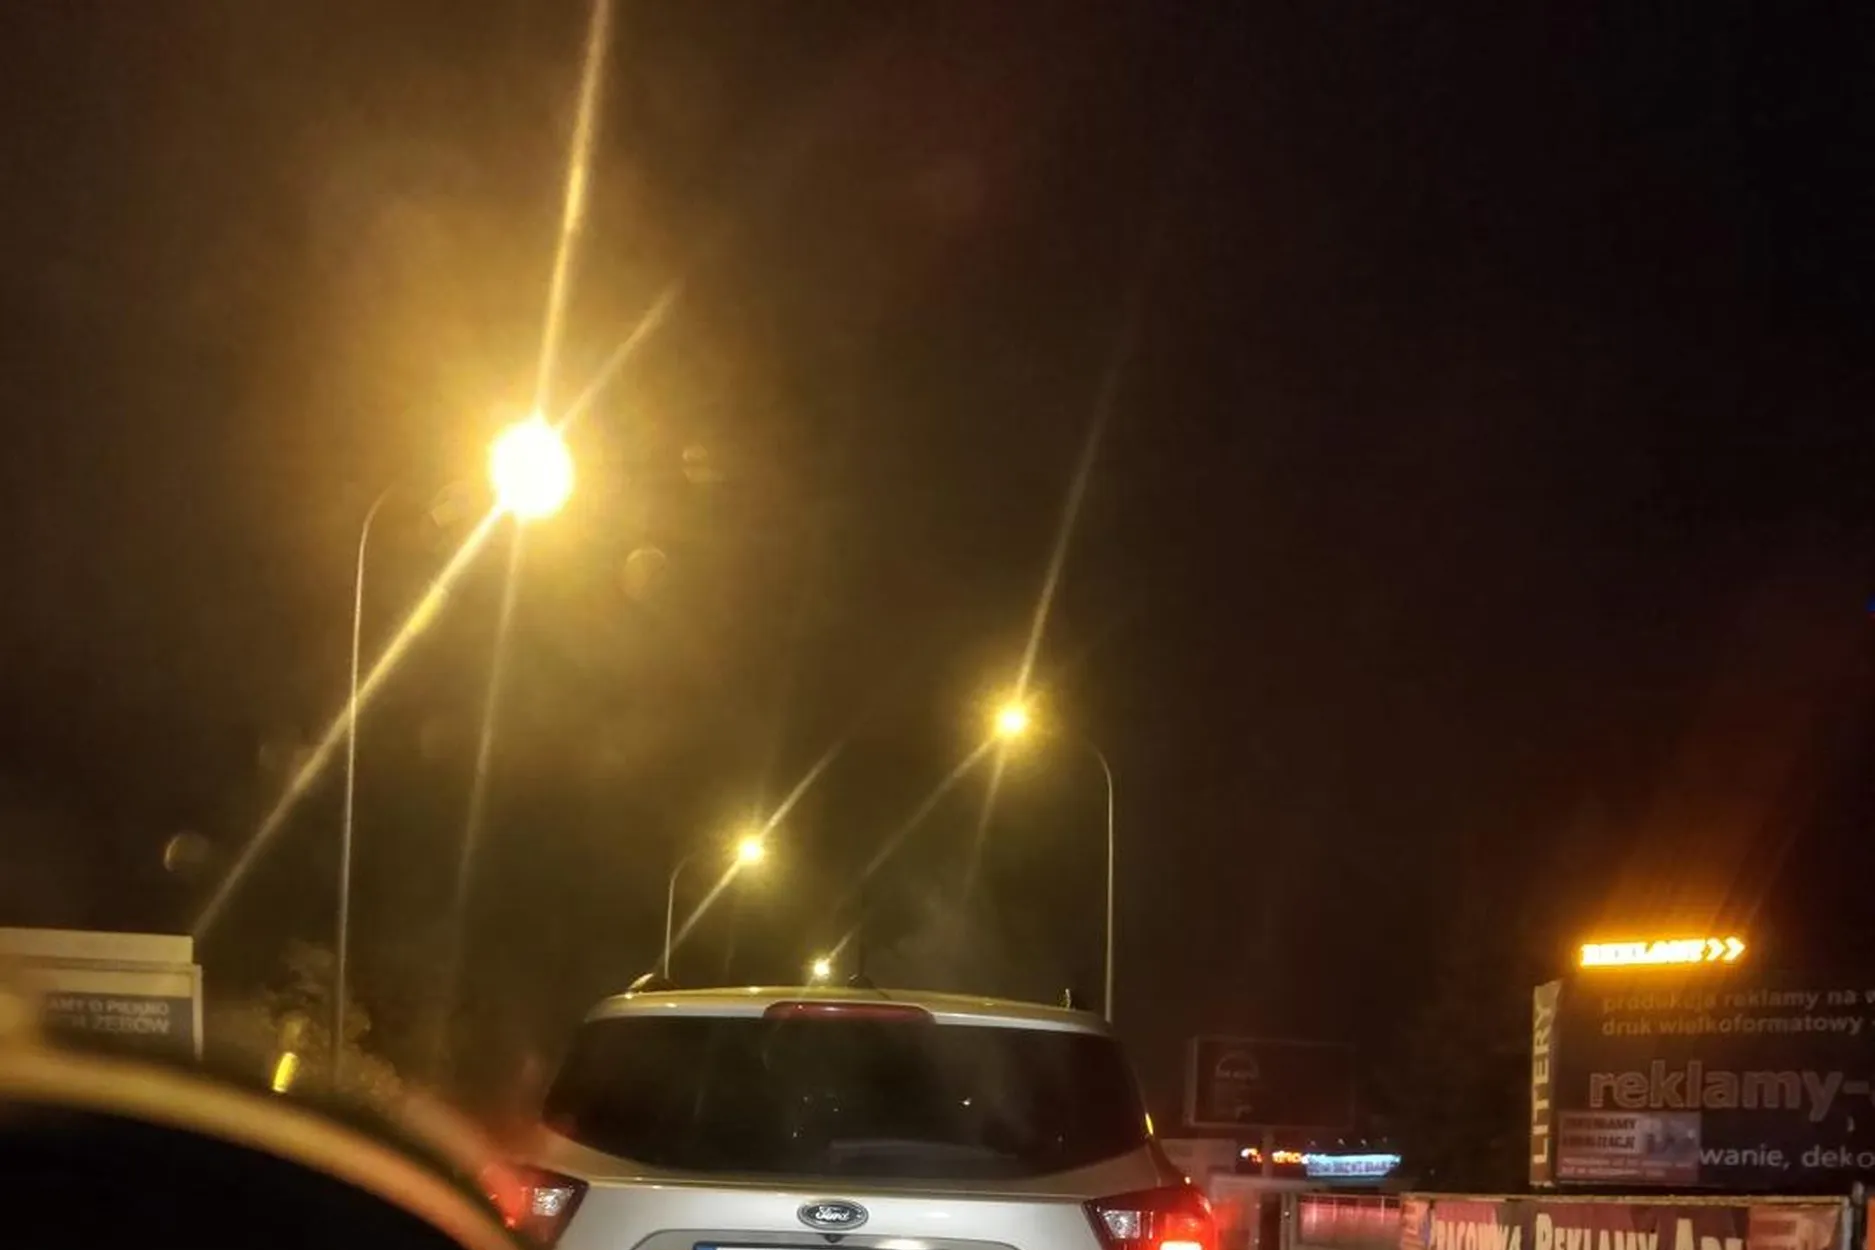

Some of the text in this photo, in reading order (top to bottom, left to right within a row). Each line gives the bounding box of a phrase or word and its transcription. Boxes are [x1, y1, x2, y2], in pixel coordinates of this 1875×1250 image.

[1724, 987, 1818, 1011] reklamy
[1827, 989, 1857, 1005] na
[1602, 1012, 1863, 1036] druk wielkoformatowy
[1532, 1004, 1551, 1164] LITERY
[1588, 1059, 1875, 1123] reklamy-
[815, 1206, 850, 1222] Ford
